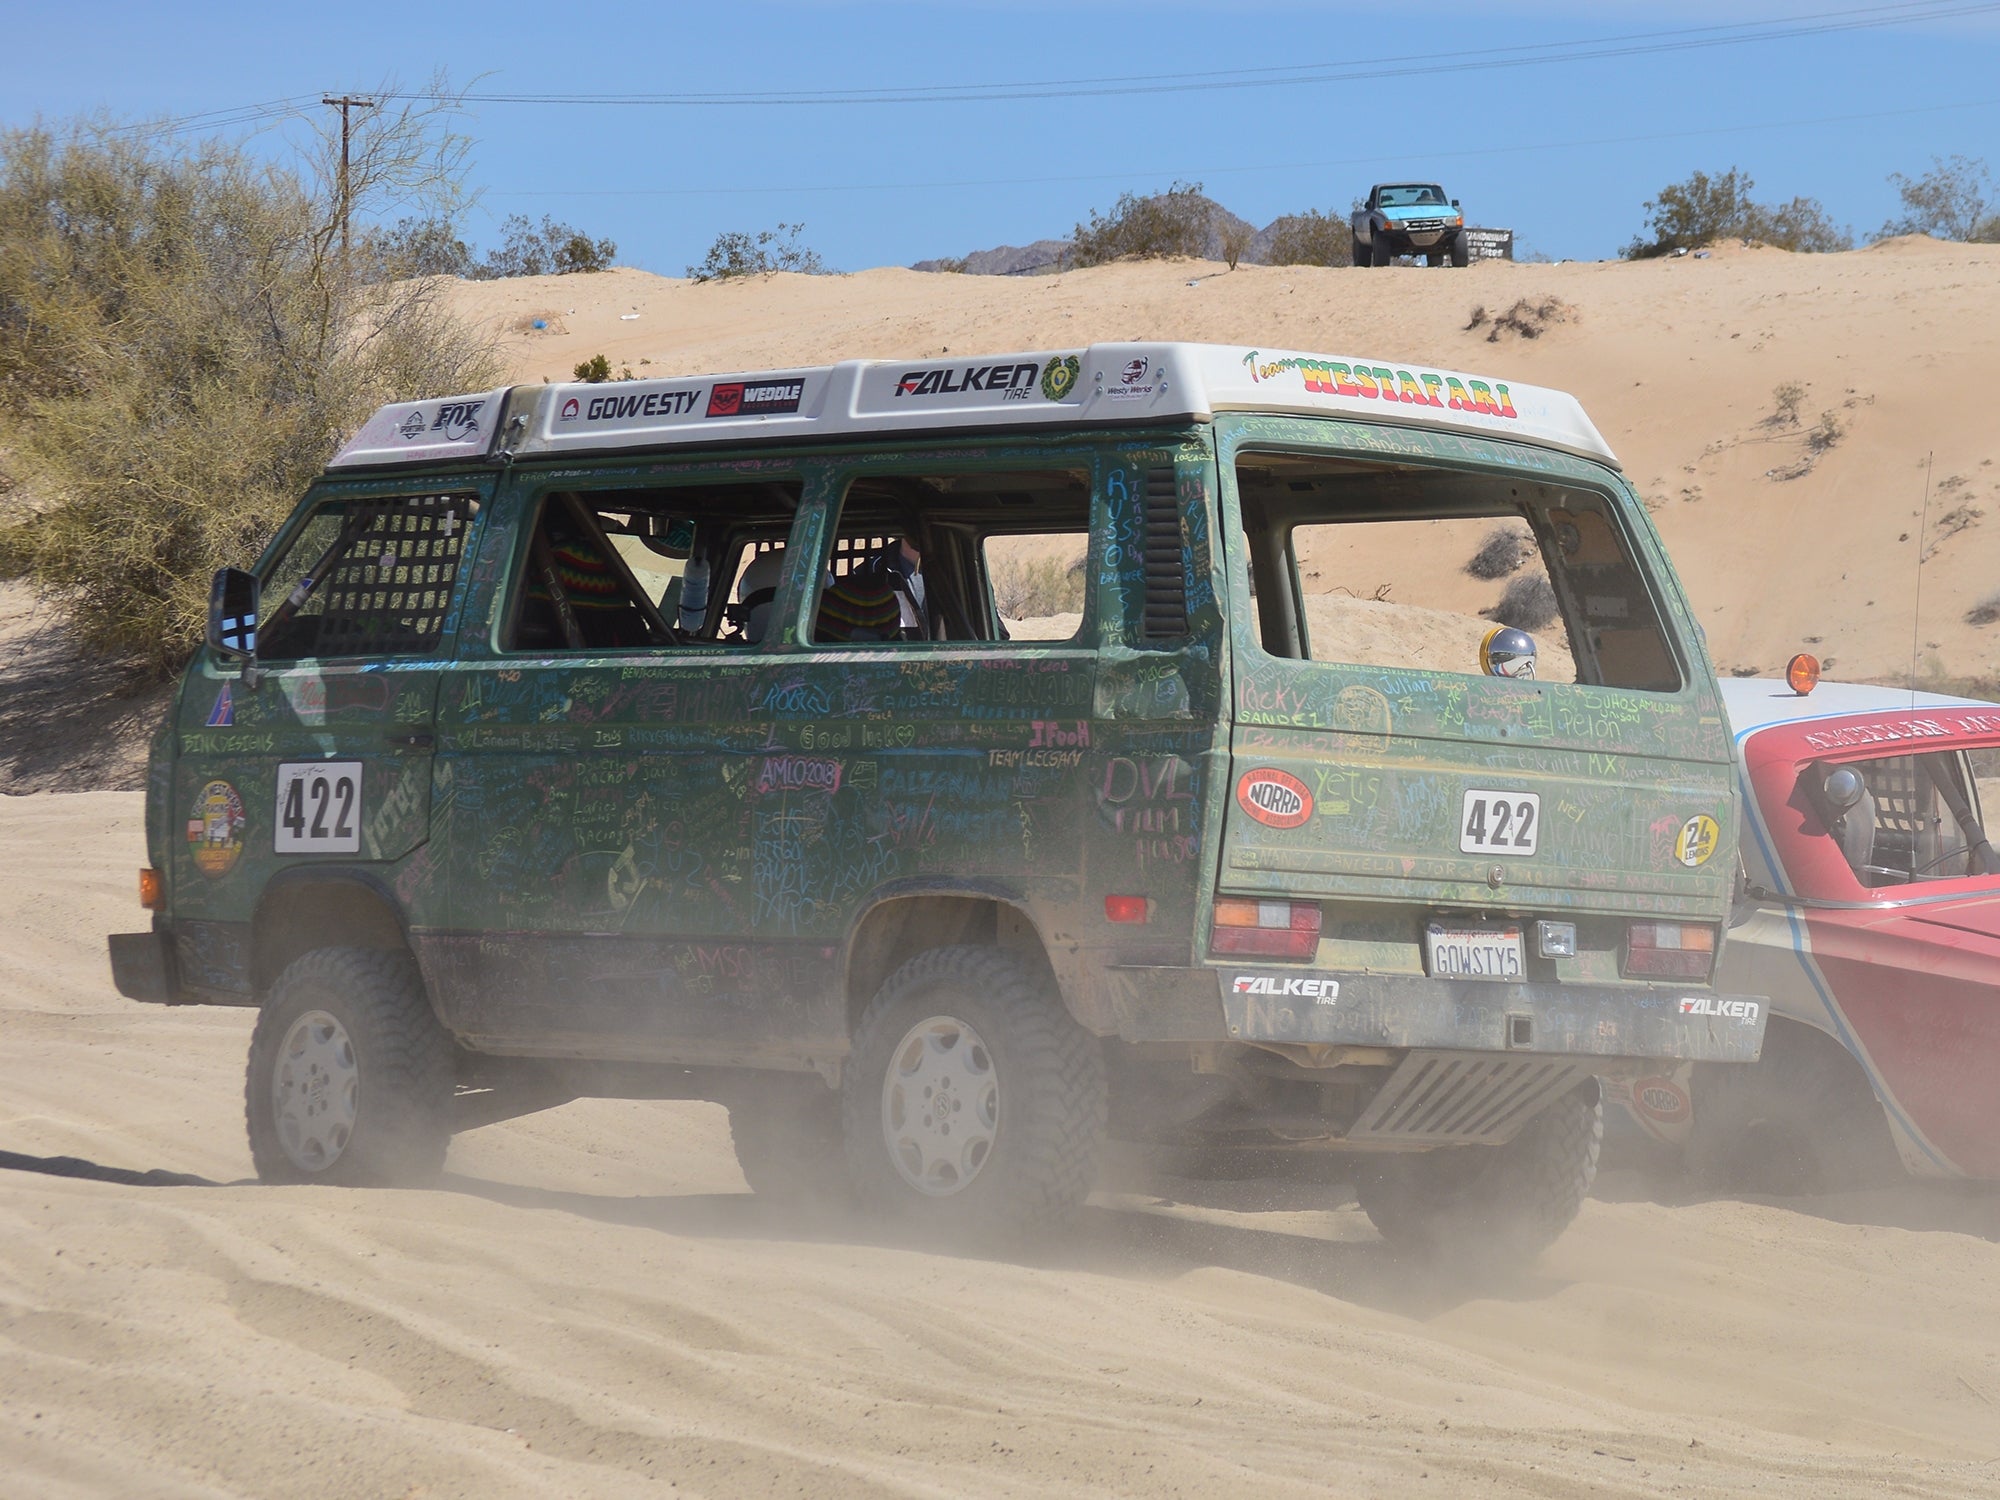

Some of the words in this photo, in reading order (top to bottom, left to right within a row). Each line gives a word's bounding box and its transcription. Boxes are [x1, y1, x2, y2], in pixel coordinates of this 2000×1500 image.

[744, 385, 801, 402] WEDDLE
[895, 363, 1039, 397] FALKEN
[1002, 388, 1030, 400] TIRE
[1242, 351, 1300, 383] Team
[1295, 358, 1518, 418] WESTAFARI
[431, 400, 486, 431] FOX
[587, 390, 701, 420] GOWESTY
[1804, 718, 1954, 751] AMERICAN
[283, 776, 354, 839] 422
[1250, 783, 1301, 814] NORRA
[1464, 799, 1536, 848] 422
[1686, 820, 1711, 849] 24
[1436, 944, 1519, 976] GOWSTY5
[1232, 976, 1341, 999] FALKEN
[1315, 996, 1338, 1006] TIRE
[1679, 997, 1760, 1019] FALKEN
[1740, 1017, 1757, 1027] TIRE
